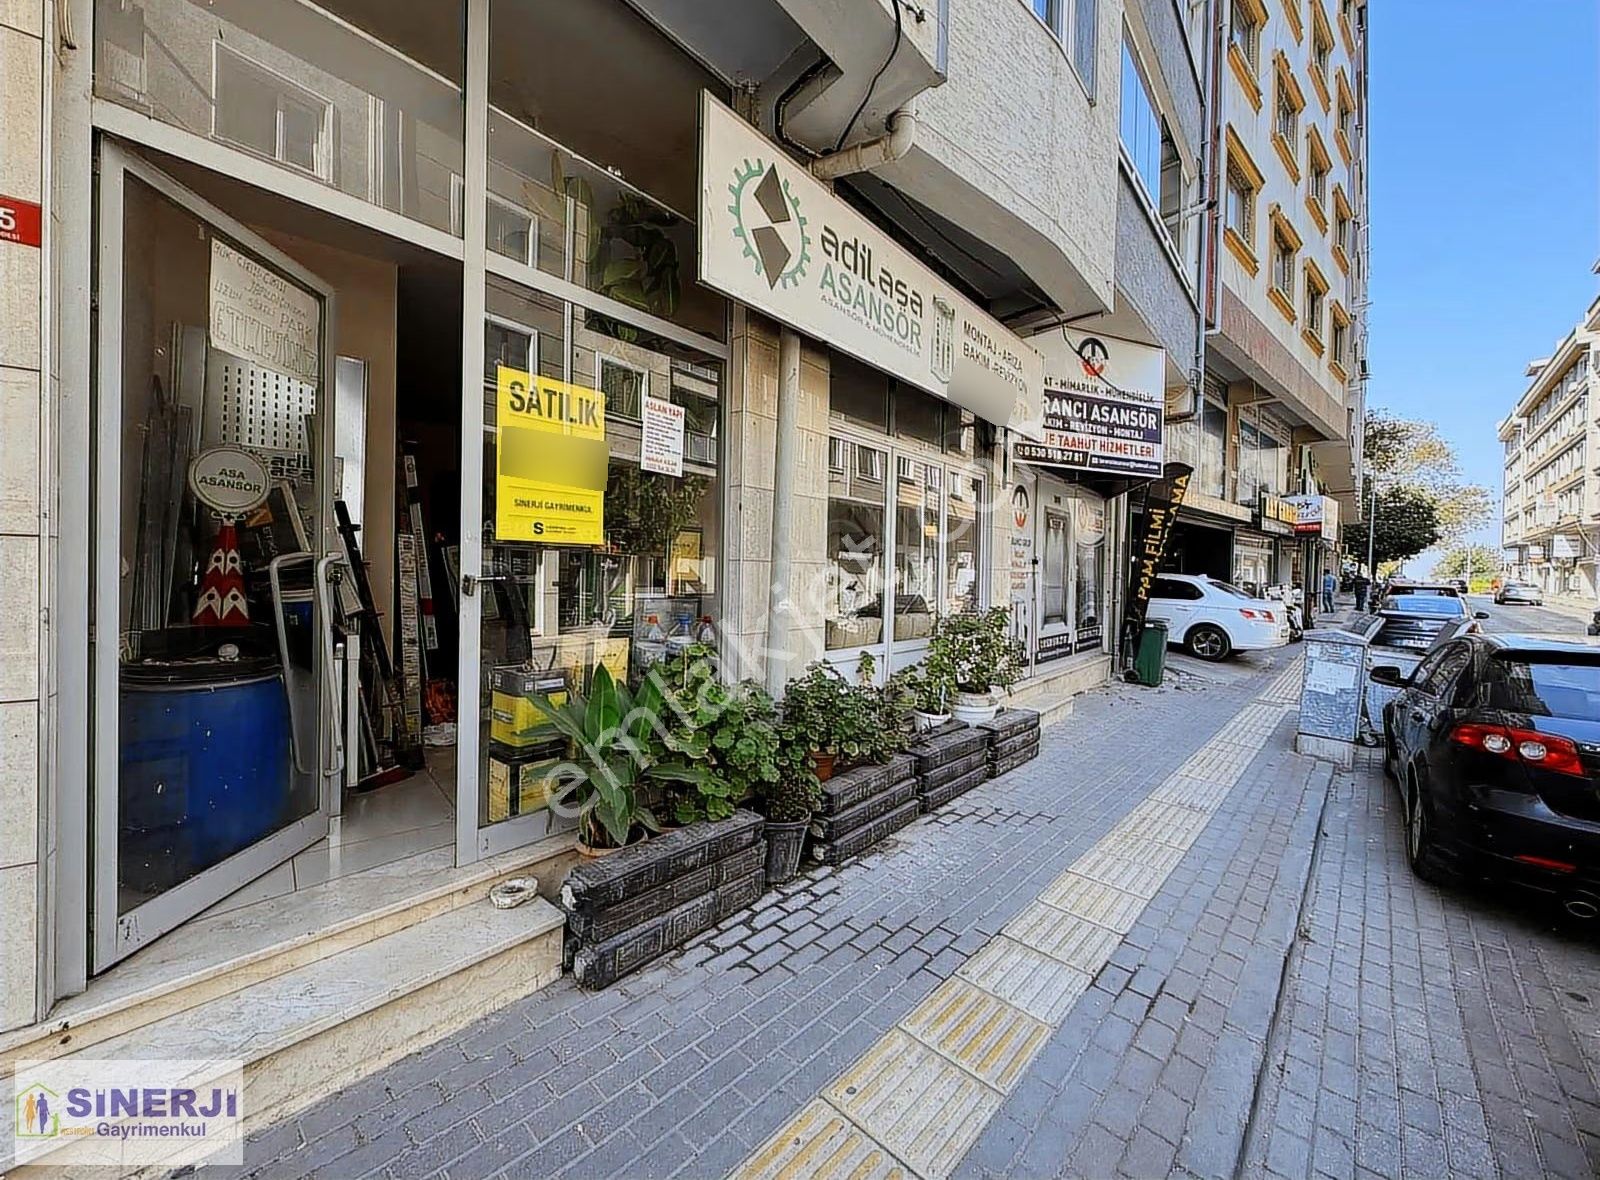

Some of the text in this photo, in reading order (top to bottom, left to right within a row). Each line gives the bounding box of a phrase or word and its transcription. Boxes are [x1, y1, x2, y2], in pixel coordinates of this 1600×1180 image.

[820, 262, 922, 350] ASANSÖR
[963, 320, 996, 355] MONTAJ
[509, 380, 600, 428] SATILIK
[1091, 402, 1157, 430] ASANSÖR
[1114, 427, 1144, 439] MONTAJ
[219, 468, 245, 480] ASA
[533, 522, 544, 535] S
[1142, 507, 1166, 556] FİLMİ
